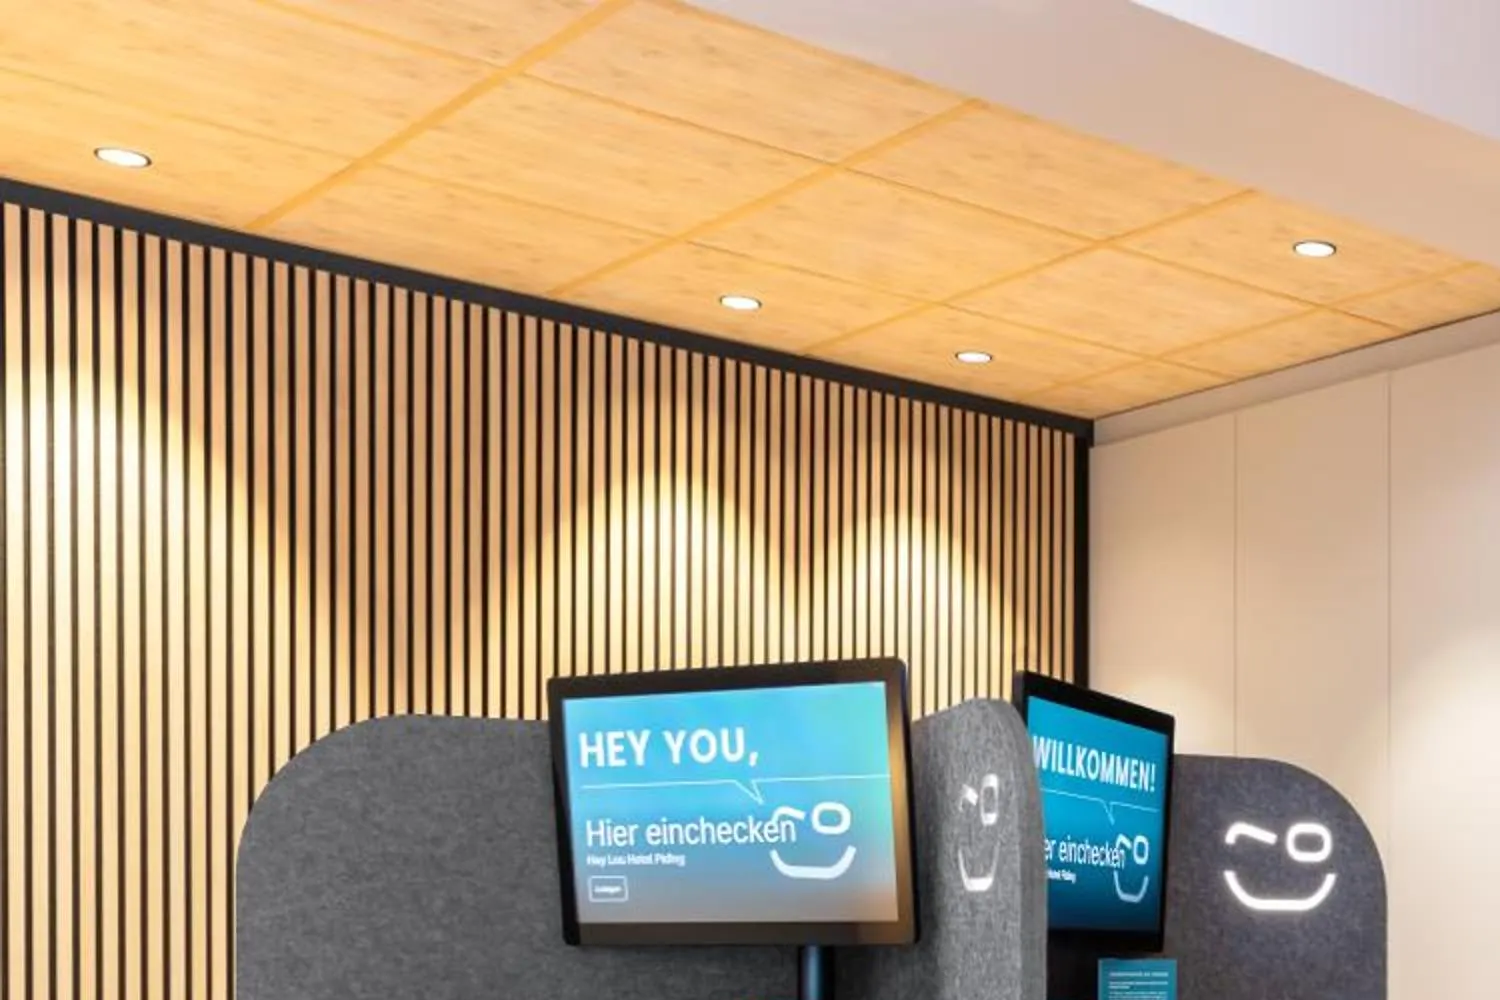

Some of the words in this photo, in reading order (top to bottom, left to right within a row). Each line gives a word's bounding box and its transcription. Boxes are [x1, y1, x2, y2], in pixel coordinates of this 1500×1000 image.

[579, 729, 651, 768] HEY
[662, 726, 759, 767] YOU,
[1033, 735, 1156, 792] WILLKOMMEN!
[585, 818, 638, 847] Hier
[647, 816, 796, 845] einchecken
[1059, 834, 1125, 869] einchecken
